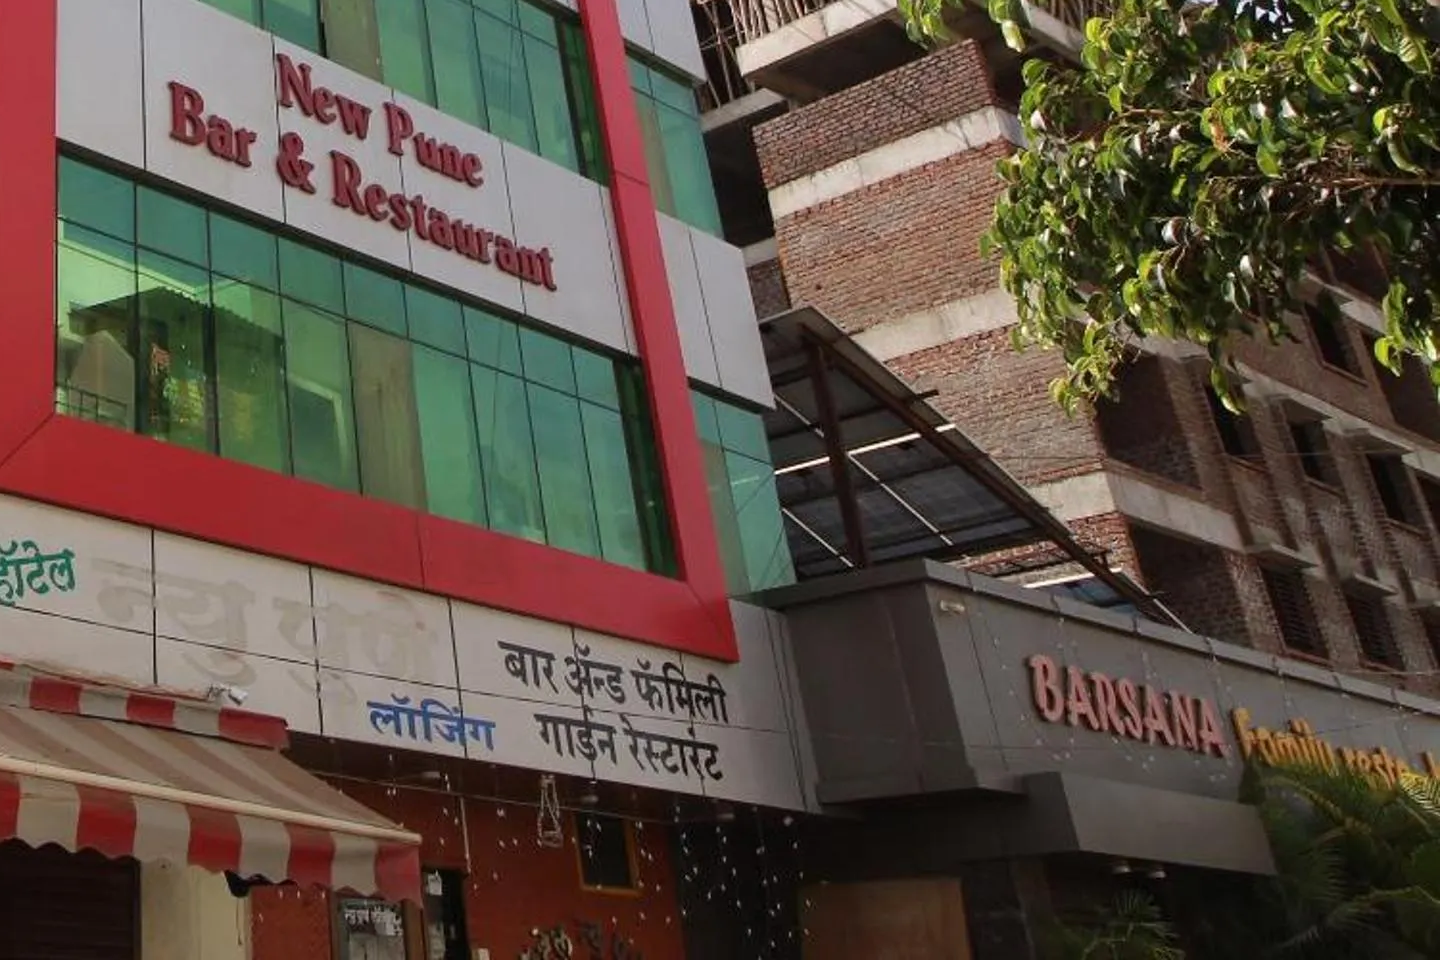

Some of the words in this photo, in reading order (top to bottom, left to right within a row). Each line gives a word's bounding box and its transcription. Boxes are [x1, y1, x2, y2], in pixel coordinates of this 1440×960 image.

[276, 53, 372, 139] New
[384, 102, 483, 187] Pune
[169, 81, 257, 167] Bar
[276, 132, 316, 194] &
[330, 150, 557, 291] Restaurant
[497, 640, 558, 693] बार
[1026, 654, 1230, 758] BARSANA
[367, 693, 495, 751] लॉजिंग
[533, 705, 617, 765] गार्डन
